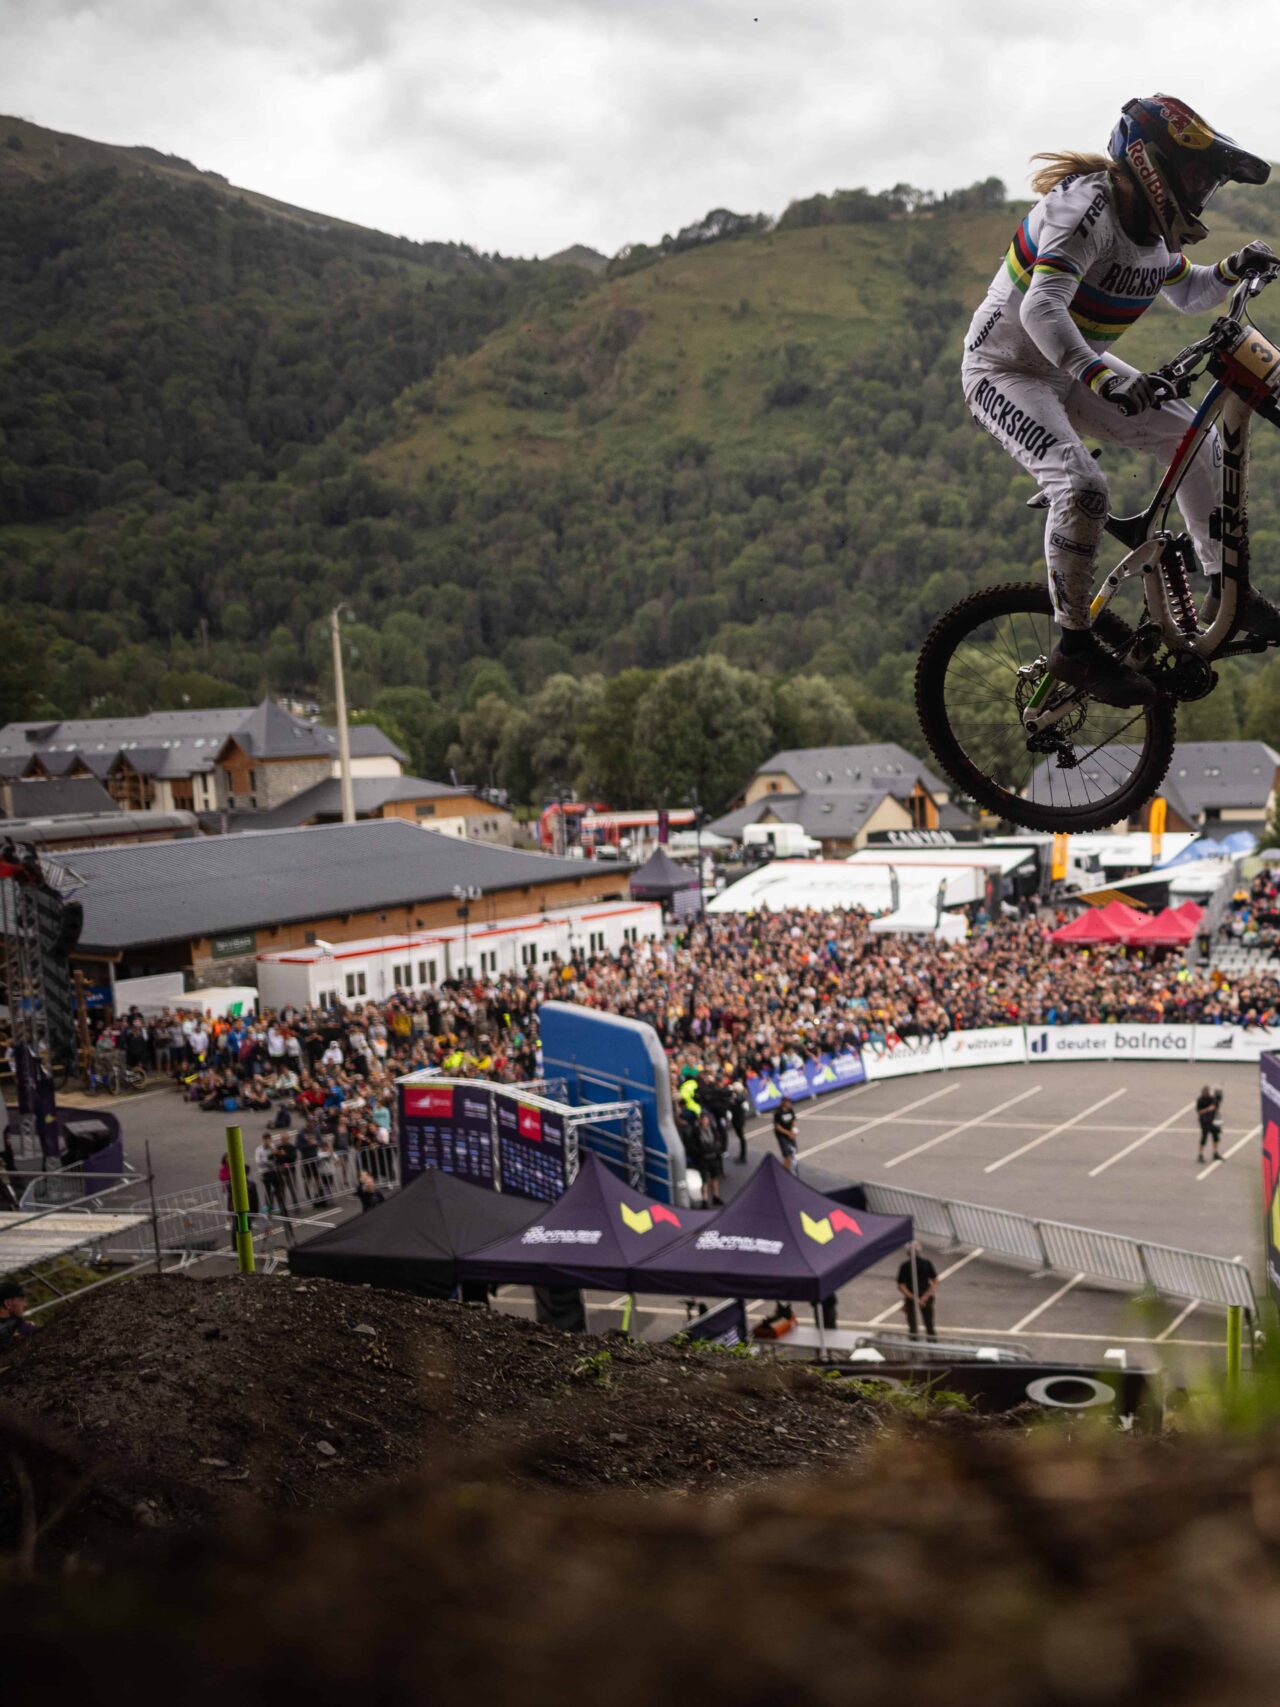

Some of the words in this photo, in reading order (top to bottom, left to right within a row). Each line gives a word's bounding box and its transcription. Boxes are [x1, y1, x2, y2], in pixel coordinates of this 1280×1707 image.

[1127, 140, 1158, 181] Red
[1098, 263, 1168, 297] ROCKSH
[969, 307, 1002, 352] SRAM
[1250, 342, 1274, 363] 3
[975, 377, 1059, 460] ROCKSHOX
[1222, 420, 1243, 590] TREK
[967, 1036, 1013, 1051] vittoria
[1056, 1036, 1107, 1051] deuter
[1115, 1032, 1187, 1050] balnéa
